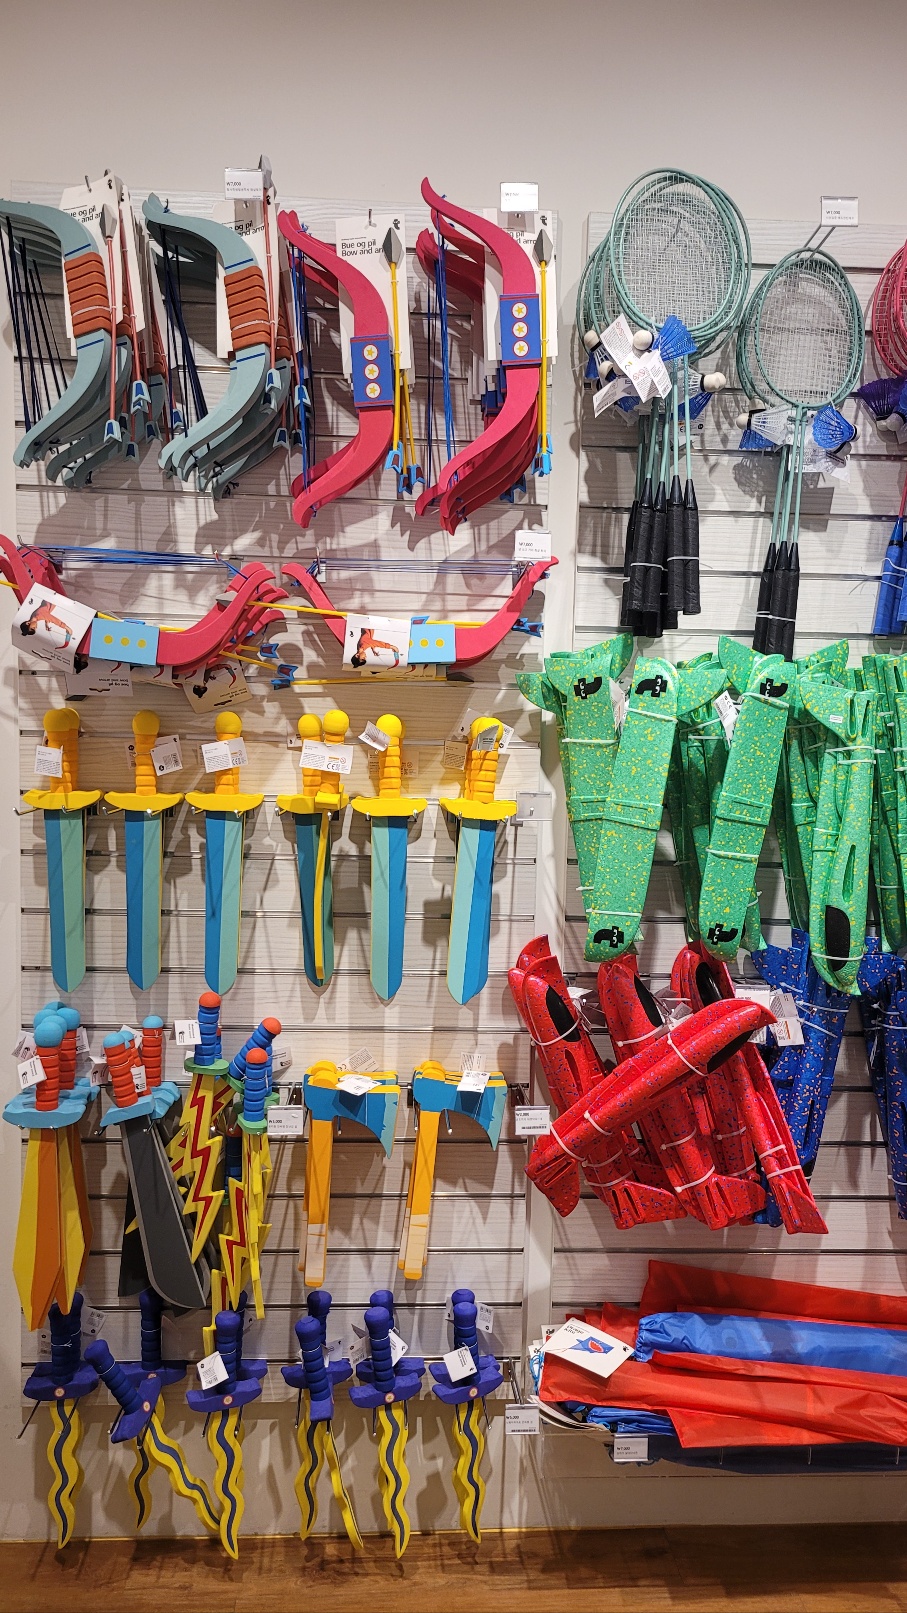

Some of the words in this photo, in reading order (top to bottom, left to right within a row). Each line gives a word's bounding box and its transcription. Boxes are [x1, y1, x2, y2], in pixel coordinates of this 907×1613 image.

[515, 230, 525, 239] pil
[341, 242, 355, 250] Bue
[356, 241, 366, 250] og
[367, 238, 377, 248] pil
[341, 249, 358, 257] Bow
[359, 246, 373, 255] and
